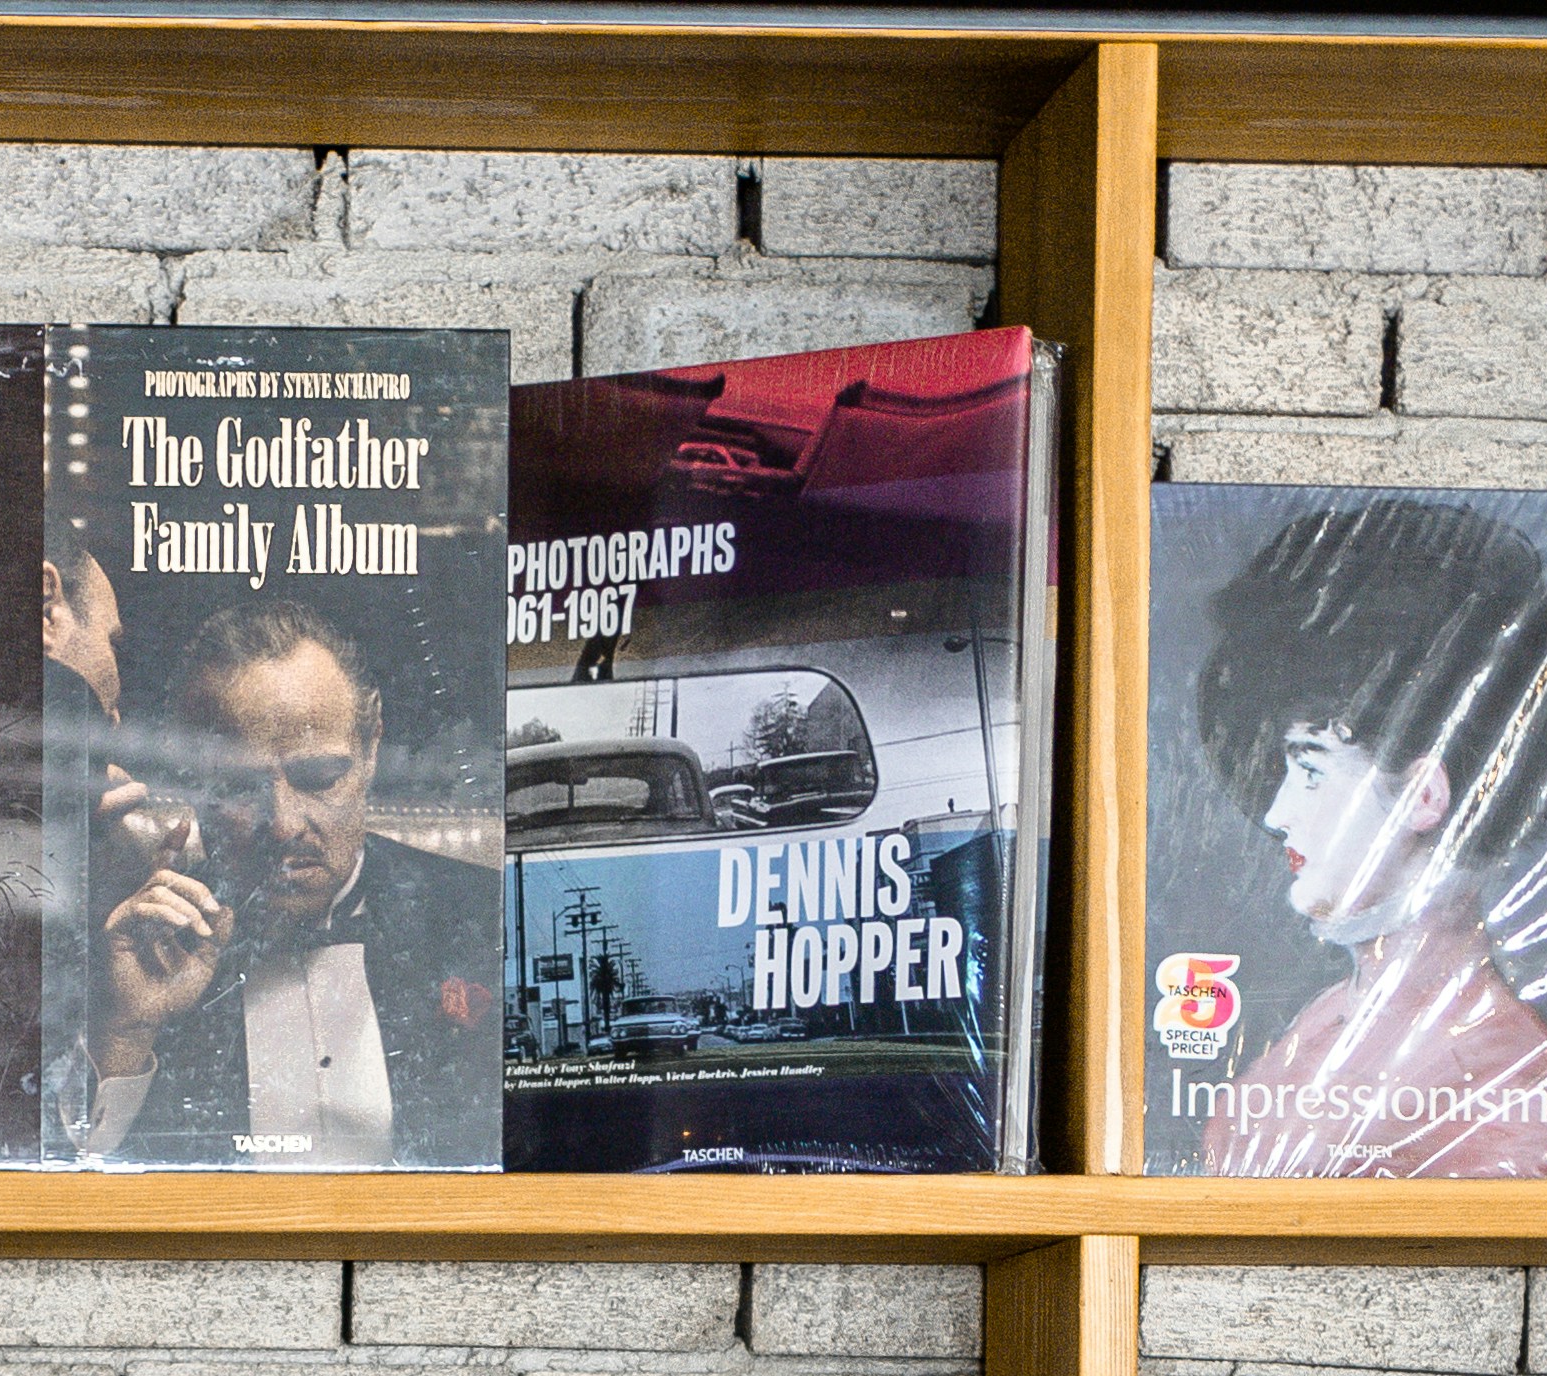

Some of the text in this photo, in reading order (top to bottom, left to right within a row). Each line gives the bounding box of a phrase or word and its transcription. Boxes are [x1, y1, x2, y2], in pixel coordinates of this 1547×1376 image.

[145, 370, 410, 400] PHOTOGRAPHS BY STEVE SCHAPIRO
[122, 416, 429, 490] The Godfather
[130, 501, 420, 590] Family Album
[507, 522, 735, 593] PHOTOGRAPHS
[717, 834, 911, 929] DENNIS
[752, 917, 963, 1010] HOPPER
[232, 1134, 312, 1152] TASCHEN
